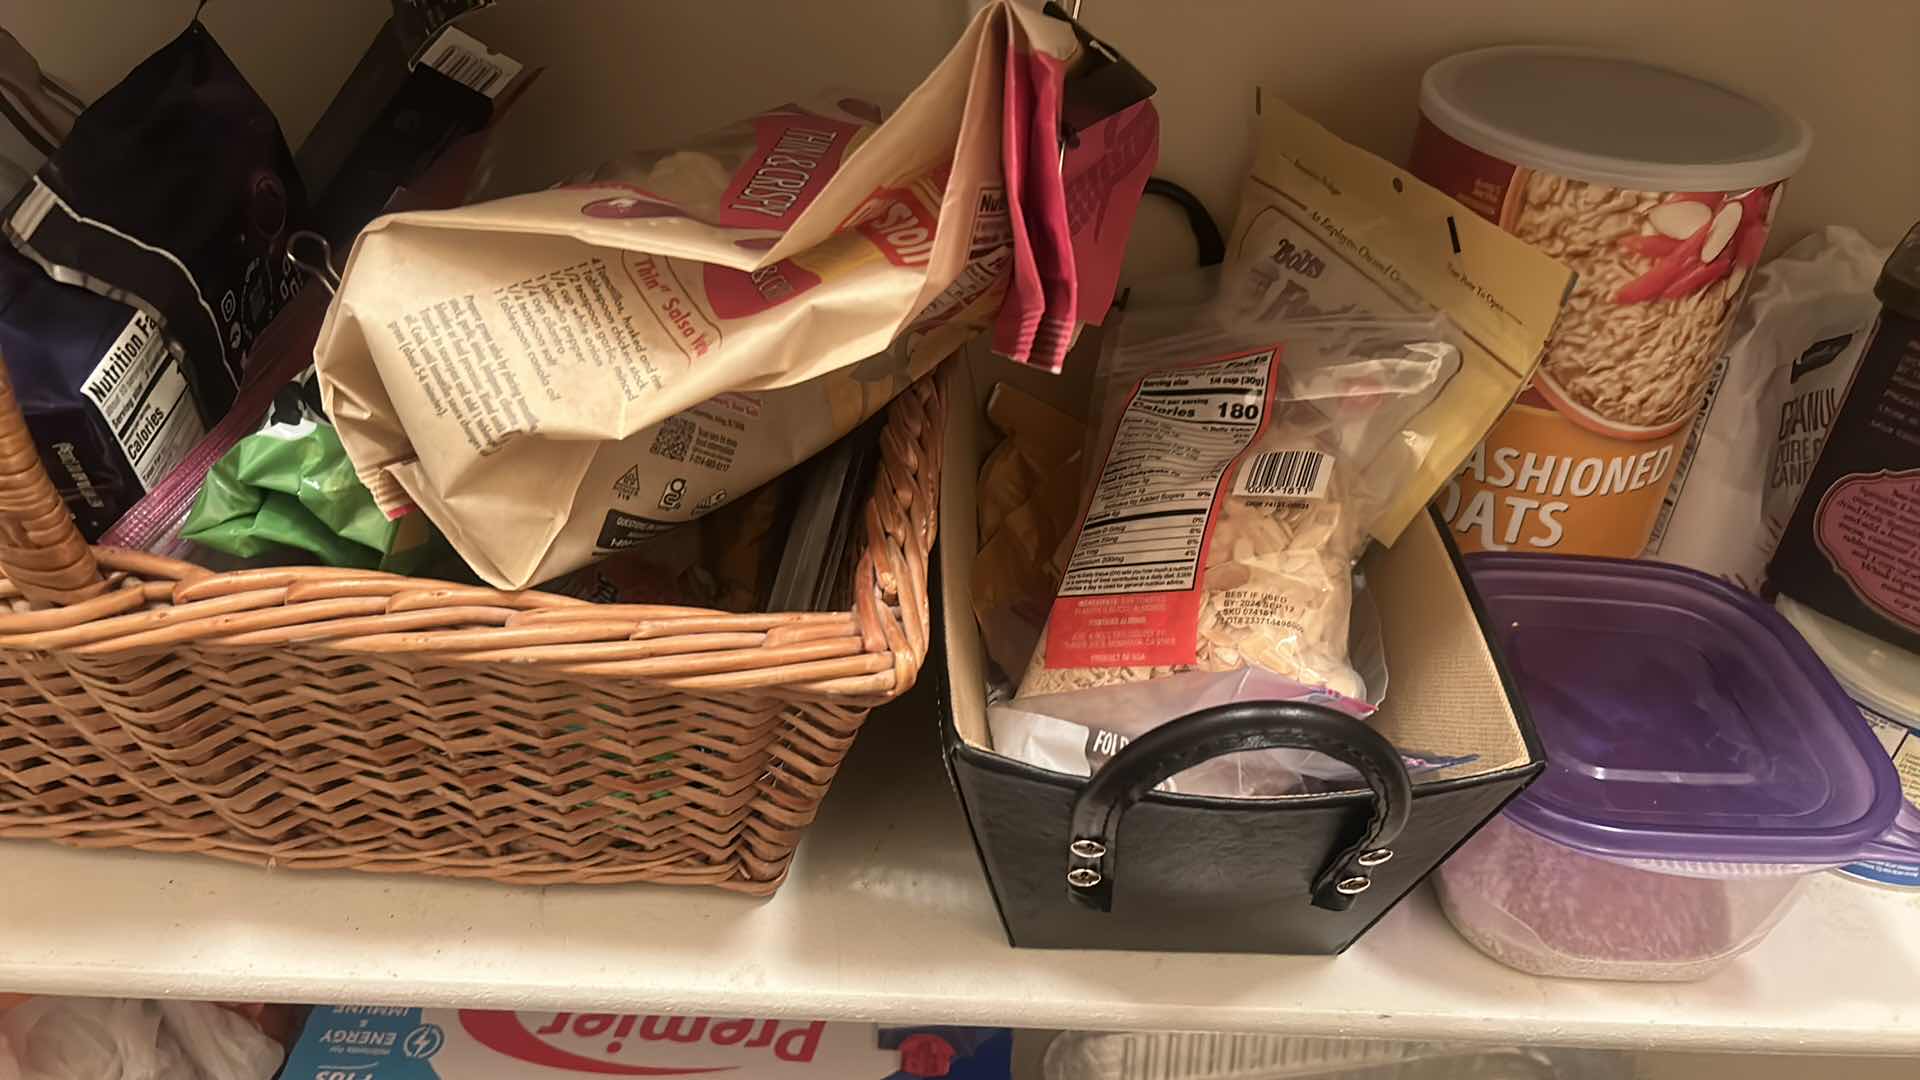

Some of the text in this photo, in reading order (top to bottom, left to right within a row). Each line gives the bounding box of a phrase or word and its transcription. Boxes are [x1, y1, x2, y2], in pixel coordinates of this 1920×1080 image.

[730, 168, 809, 217] CRISPY
[530, 297, 546, 316] cup
[559, 288, 574, 307] cup
[569, 306, 590, 335] white
[583, 336, 604, 367] onion
[573, 283, 602, 329] teaspoon
[581, 269, 615, 324] Tablespoon
[610, 324, 635, 365] chicken
[662, 297, 694, 337] Salsa
[496, 295, 531, 351] Tablespoon
[526, 350, 551, 386] canola
[516, 301, 546, 347] teaspoon
[541, 346, 557, 367] salt
[560, 324, 586, 364] pepper
[621, 315, 646, 352] husked
[639, 352, 657, 373] and
[88, 331, 144, 403] Nutrition
[1225, 377, 1239, 385] cup
[1241, 376, 1264, 386] (30g)
[126, 406, 165, 460] Calories
[1133, 401, 1259, 419] Calories 180
[1467, 441, 1673, 497] ASHIONED
[1223, 608, 1241, 616] SKU
[1224, 591, 1288, 603] BEST IF USED
[1240, 599, 1262, 608] 2024
[320, 1028, 397, 1047] ENERGY
[537, 1011, 827, 1064] Premier
